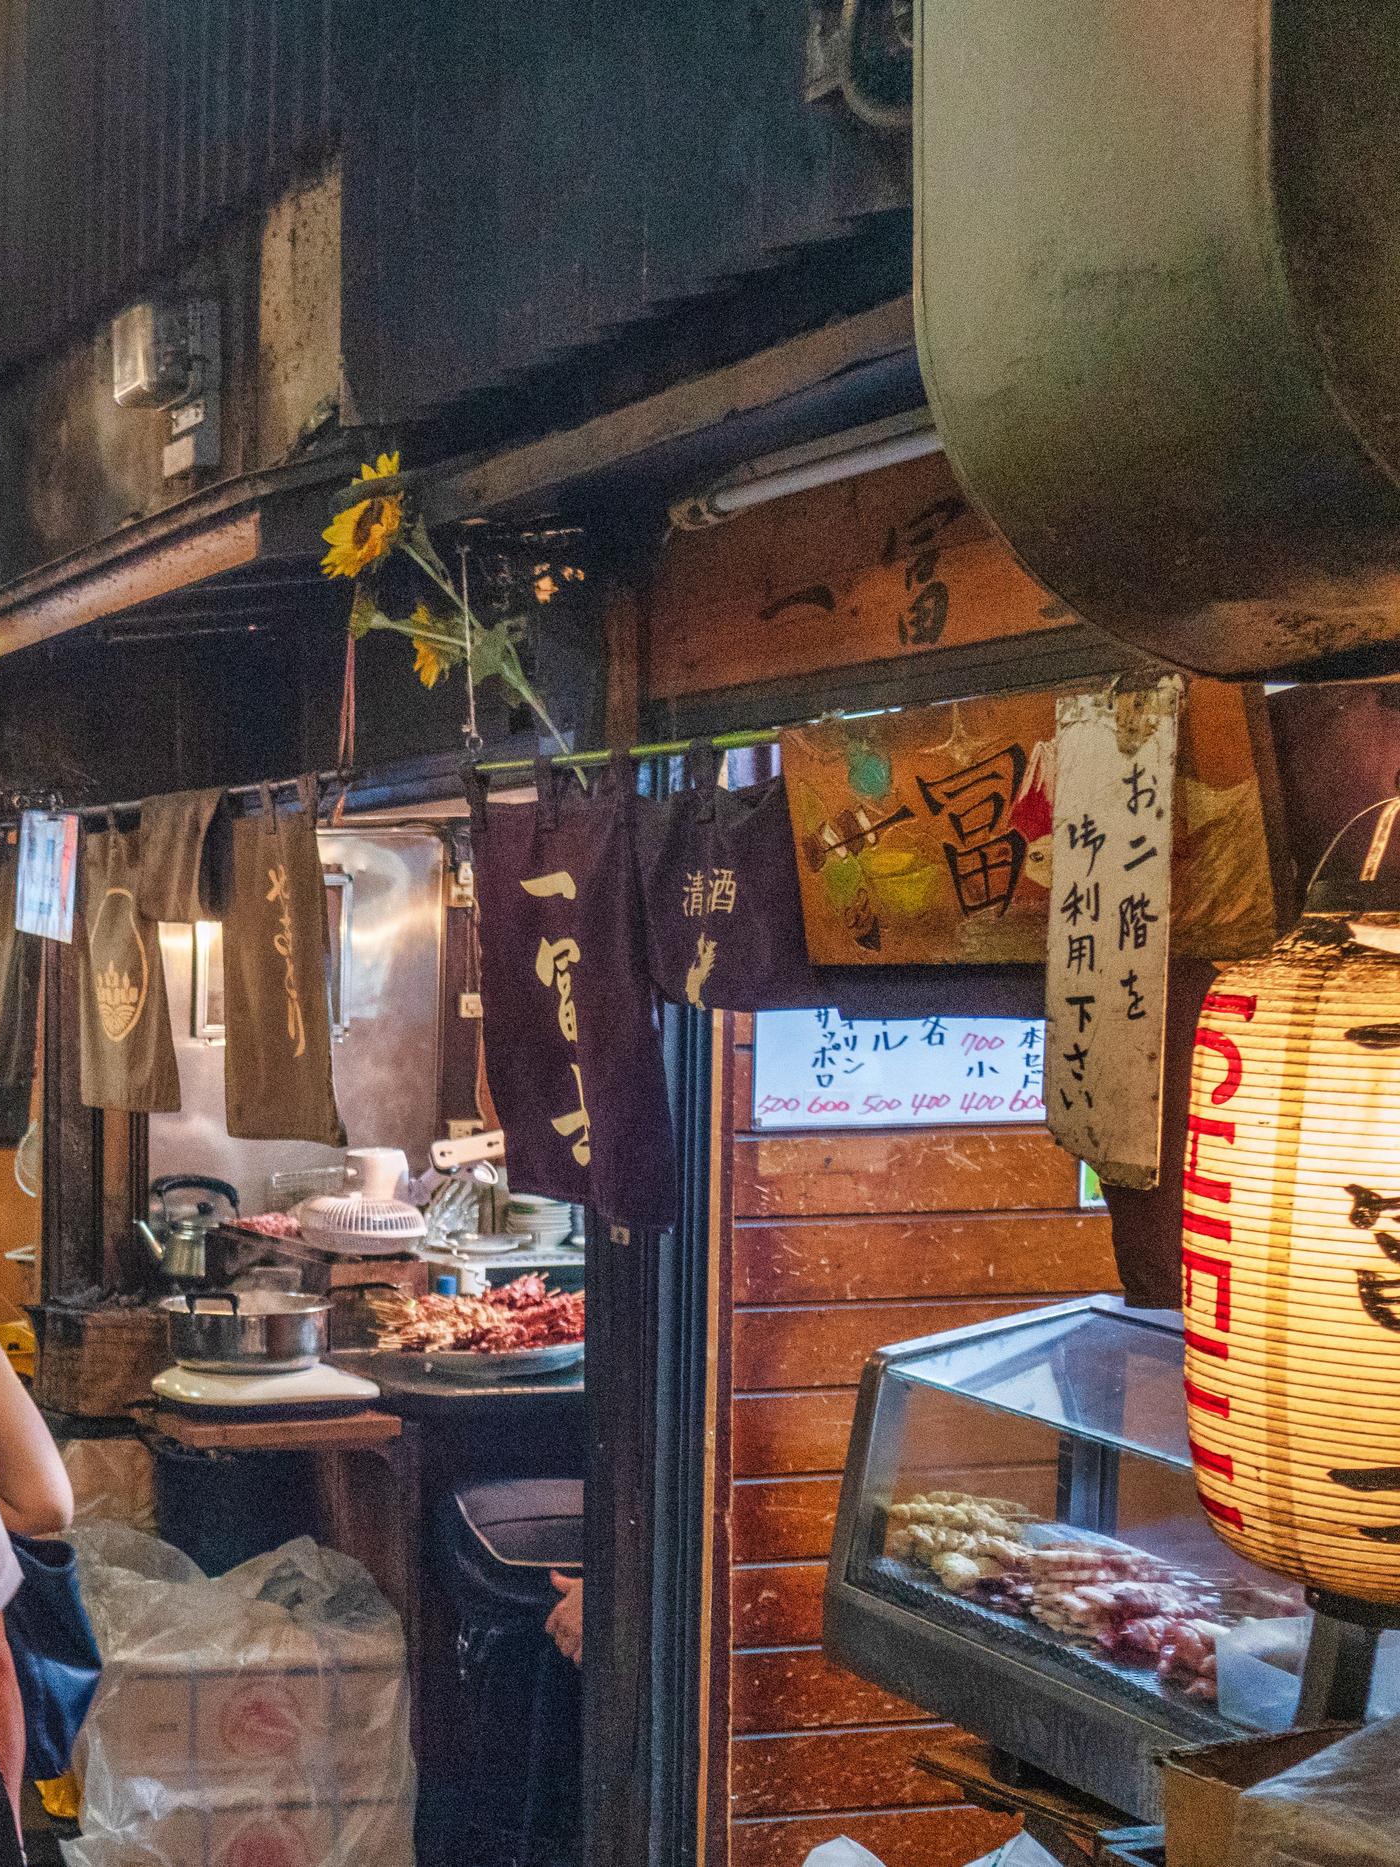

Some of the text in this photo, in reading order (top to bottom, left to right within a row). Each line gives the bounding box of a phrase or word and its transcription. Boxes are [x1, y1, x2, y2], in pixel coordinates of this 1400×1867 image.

[682, 868, 738, 917] 清酒
[1117, 762, 1159, 1021] お二階を
[961, 1032, 1005, 1056] 700
[758, 1096, 800, 1115] 500
[806, 1096, 850, 1114] 600
[857, 1095, 902, 1115] 500
[910, 1092, 952, 1116] 400
[960, 1092, 1005, 1115] 400
